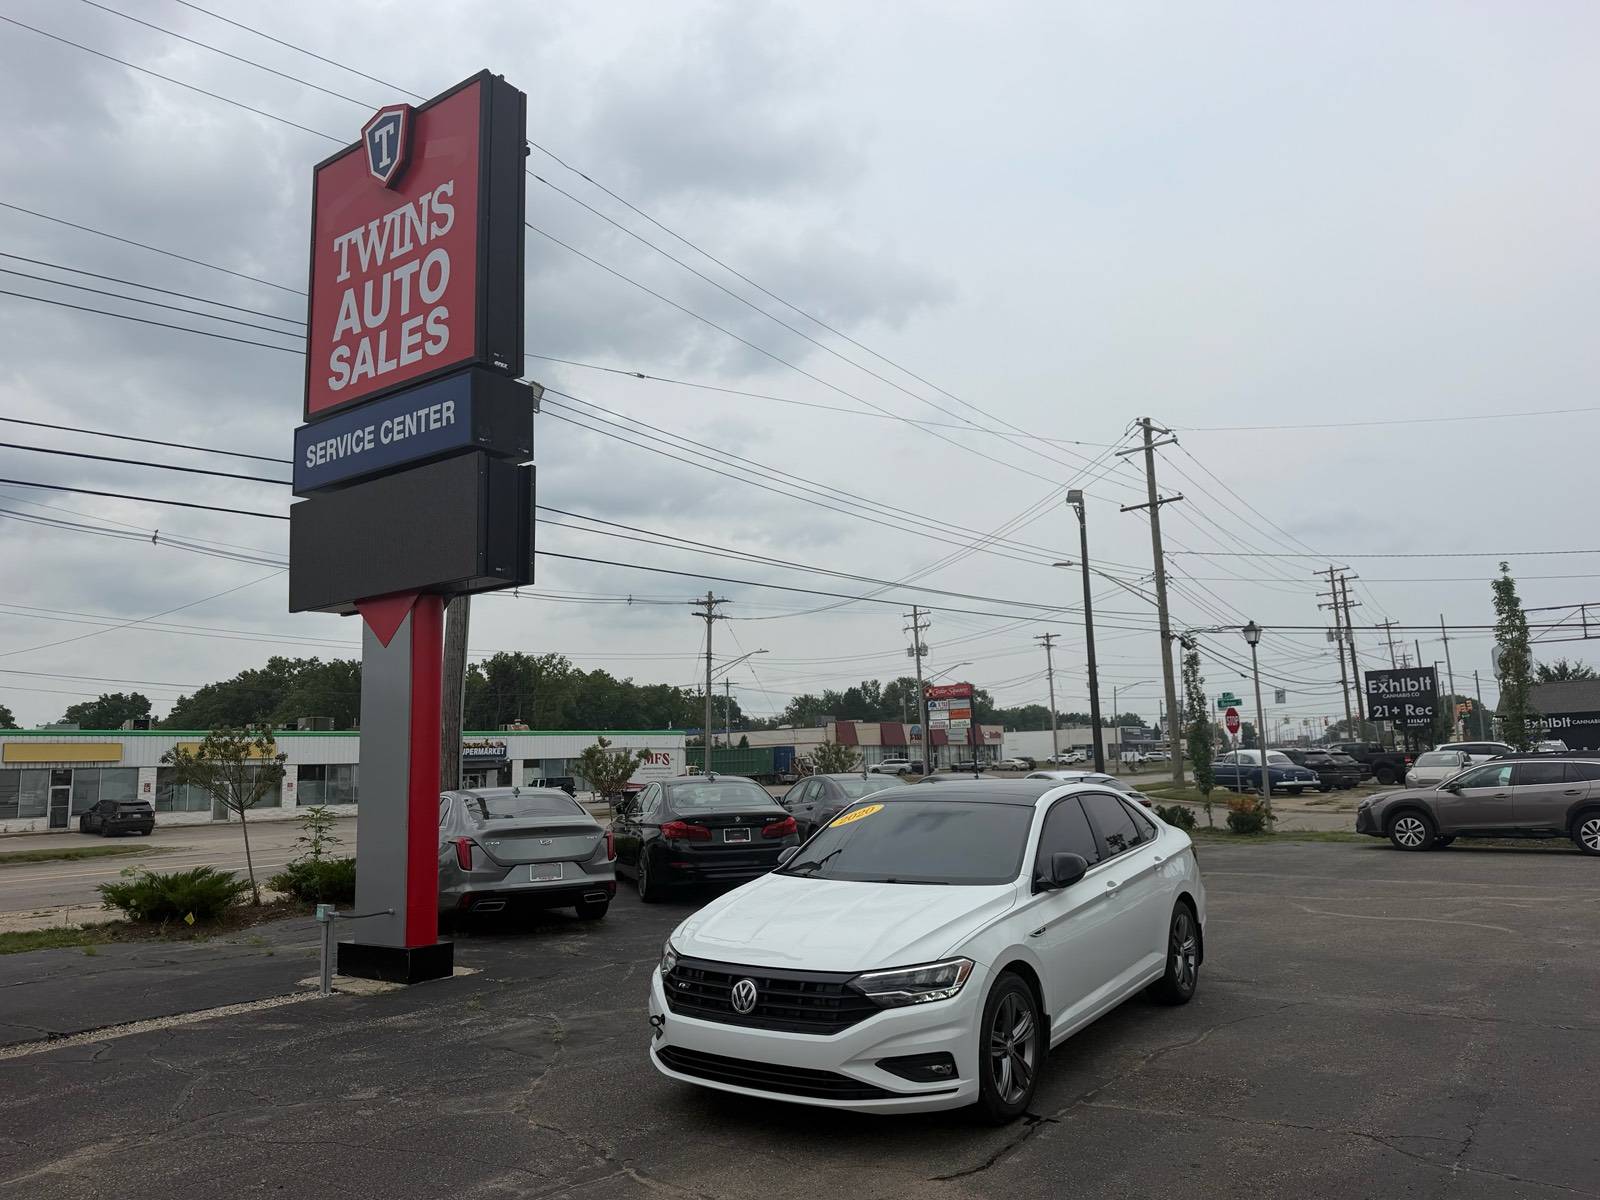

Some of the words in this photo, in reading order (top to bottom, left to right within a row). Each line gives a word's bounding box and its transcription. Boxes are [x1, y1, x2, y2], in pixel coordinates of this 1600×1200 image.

[375, 121, 394, 168] T
[333, 180, 455, 283] TWINS
[332, 248, 451, 343] AUTO
[328, 305, 450, 391] SALES
[305, 425, 375, 468] SERVICE
[380, 400, 455, 445] CENTER
[1226, 715, 1239, 726] STOP
[1373, 705, 1400, 718] 21+
[1405, 704, 1433, 716] Rec
[838, 806, 876, 825] 2020
